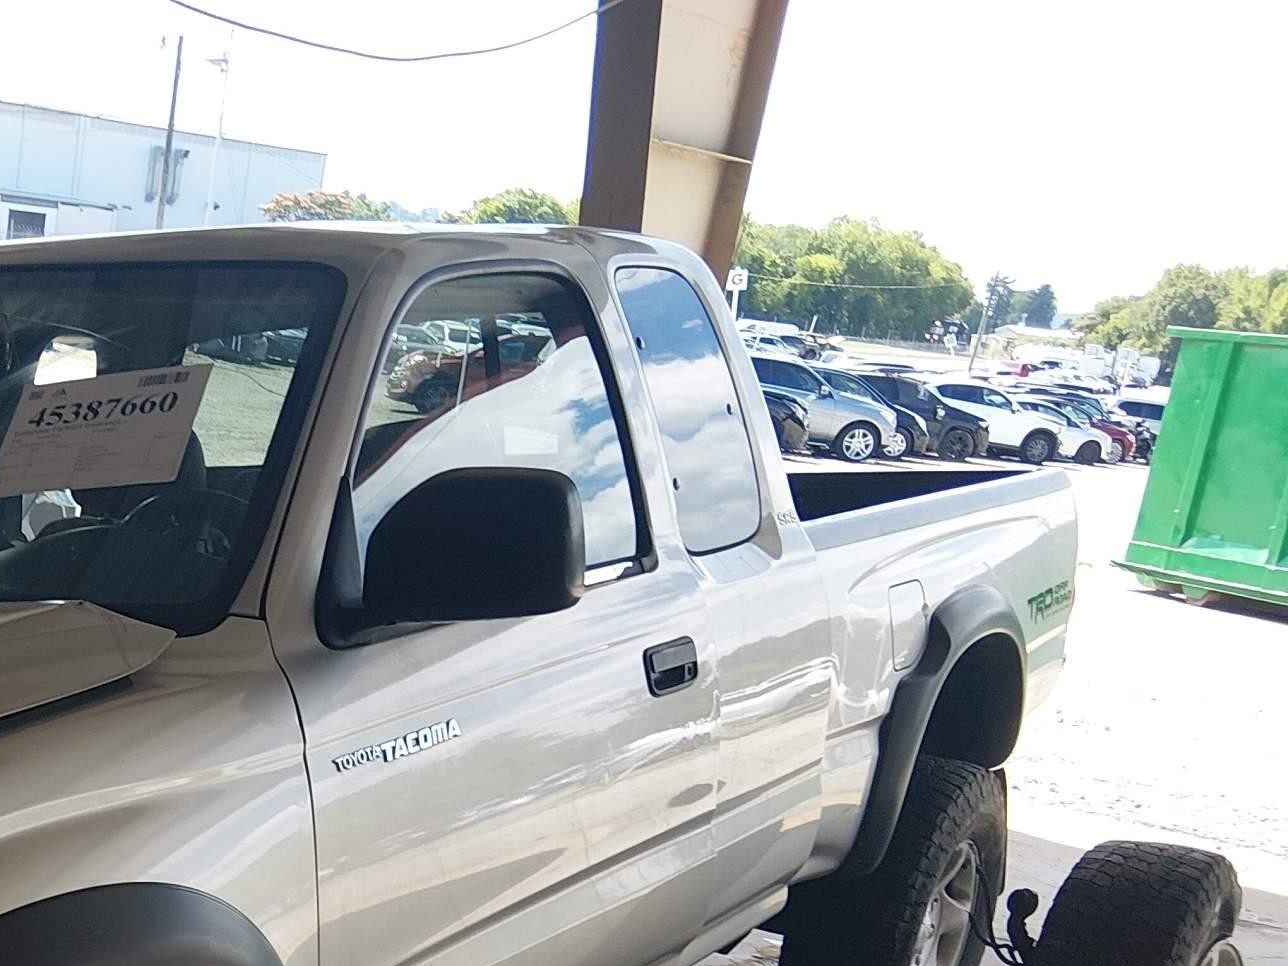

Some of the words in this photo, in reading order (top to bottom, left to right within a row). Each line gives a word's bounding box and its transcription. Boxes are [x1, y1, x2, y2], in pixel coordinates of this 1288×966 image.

[731, 273, 744, 286] G
[28, 391, 178, 427] 45387660
[332, 743, 382, 772] TOYOTA
[380, 717, 462, 763] TACOMA
